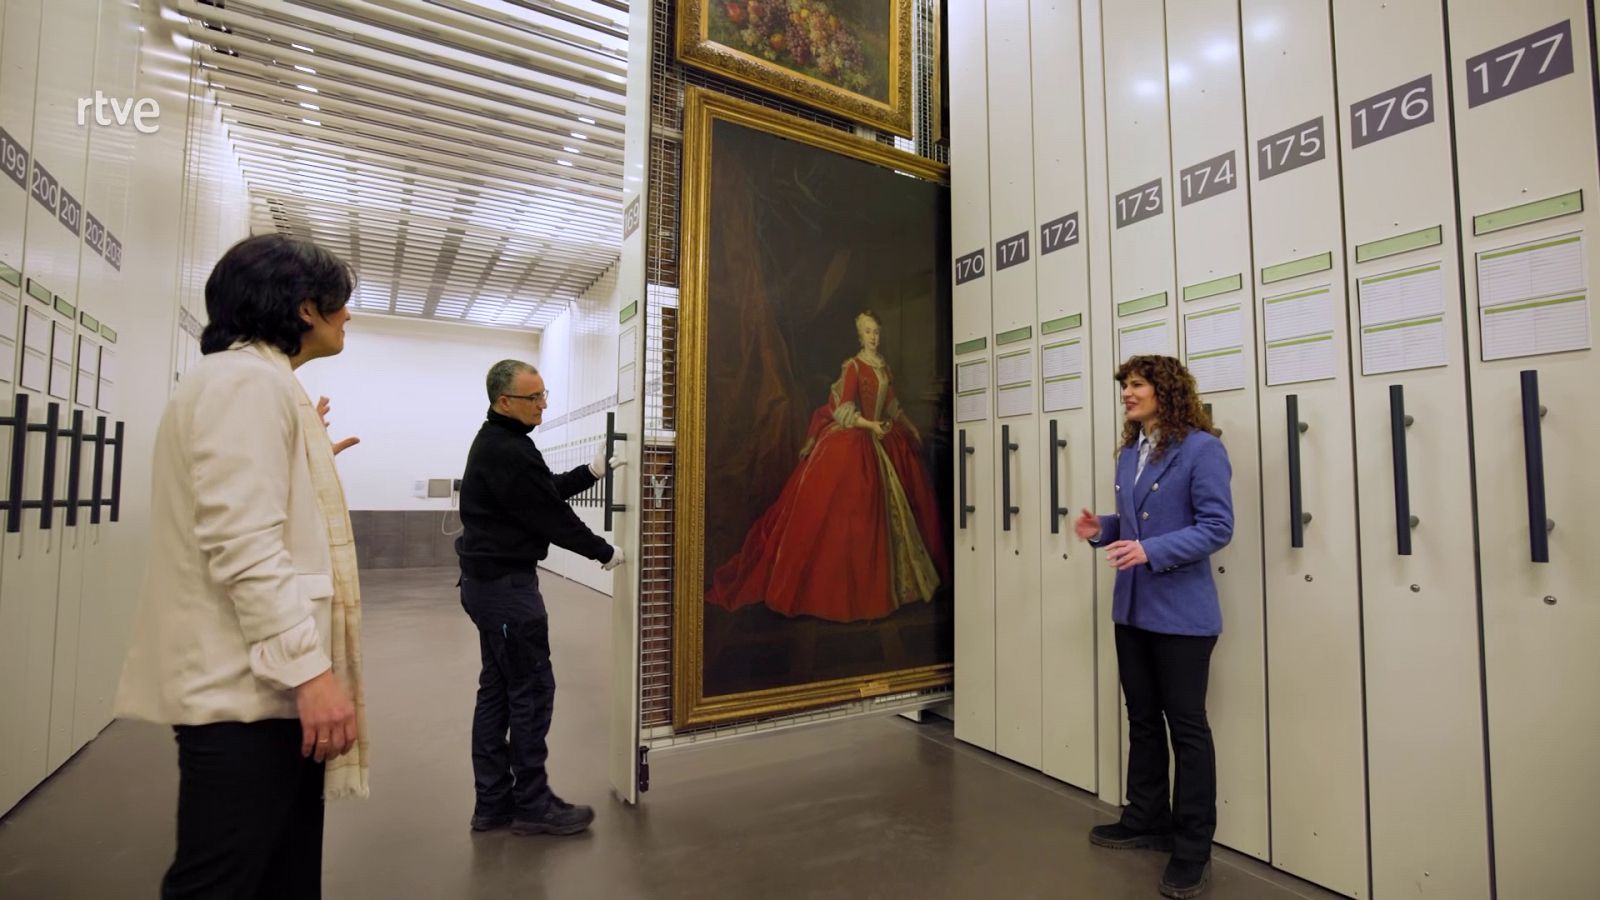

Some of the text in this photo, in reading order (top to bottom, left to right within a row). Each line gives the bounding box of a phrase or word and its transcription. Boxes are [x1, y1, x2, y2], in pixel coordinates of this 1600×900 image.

[1472, 32, 1564, 95] 177
[1354, 86, 1430, 137] 176
[0, 138, 26, 179] 199
[1261, 126, 1321, 171] 175
[32, 168, 57, 208] 200
[1182, 160, 1234, 198] 174
[61, 196, 80, 230] 201
[1118, 186, 1161, 221] 173
[86, 218, 104, 250] 202
[1000, 238, 1026, 264] 171
[1042, 219, 1078, 248] 172
[956, 254, 984, 280] 170
